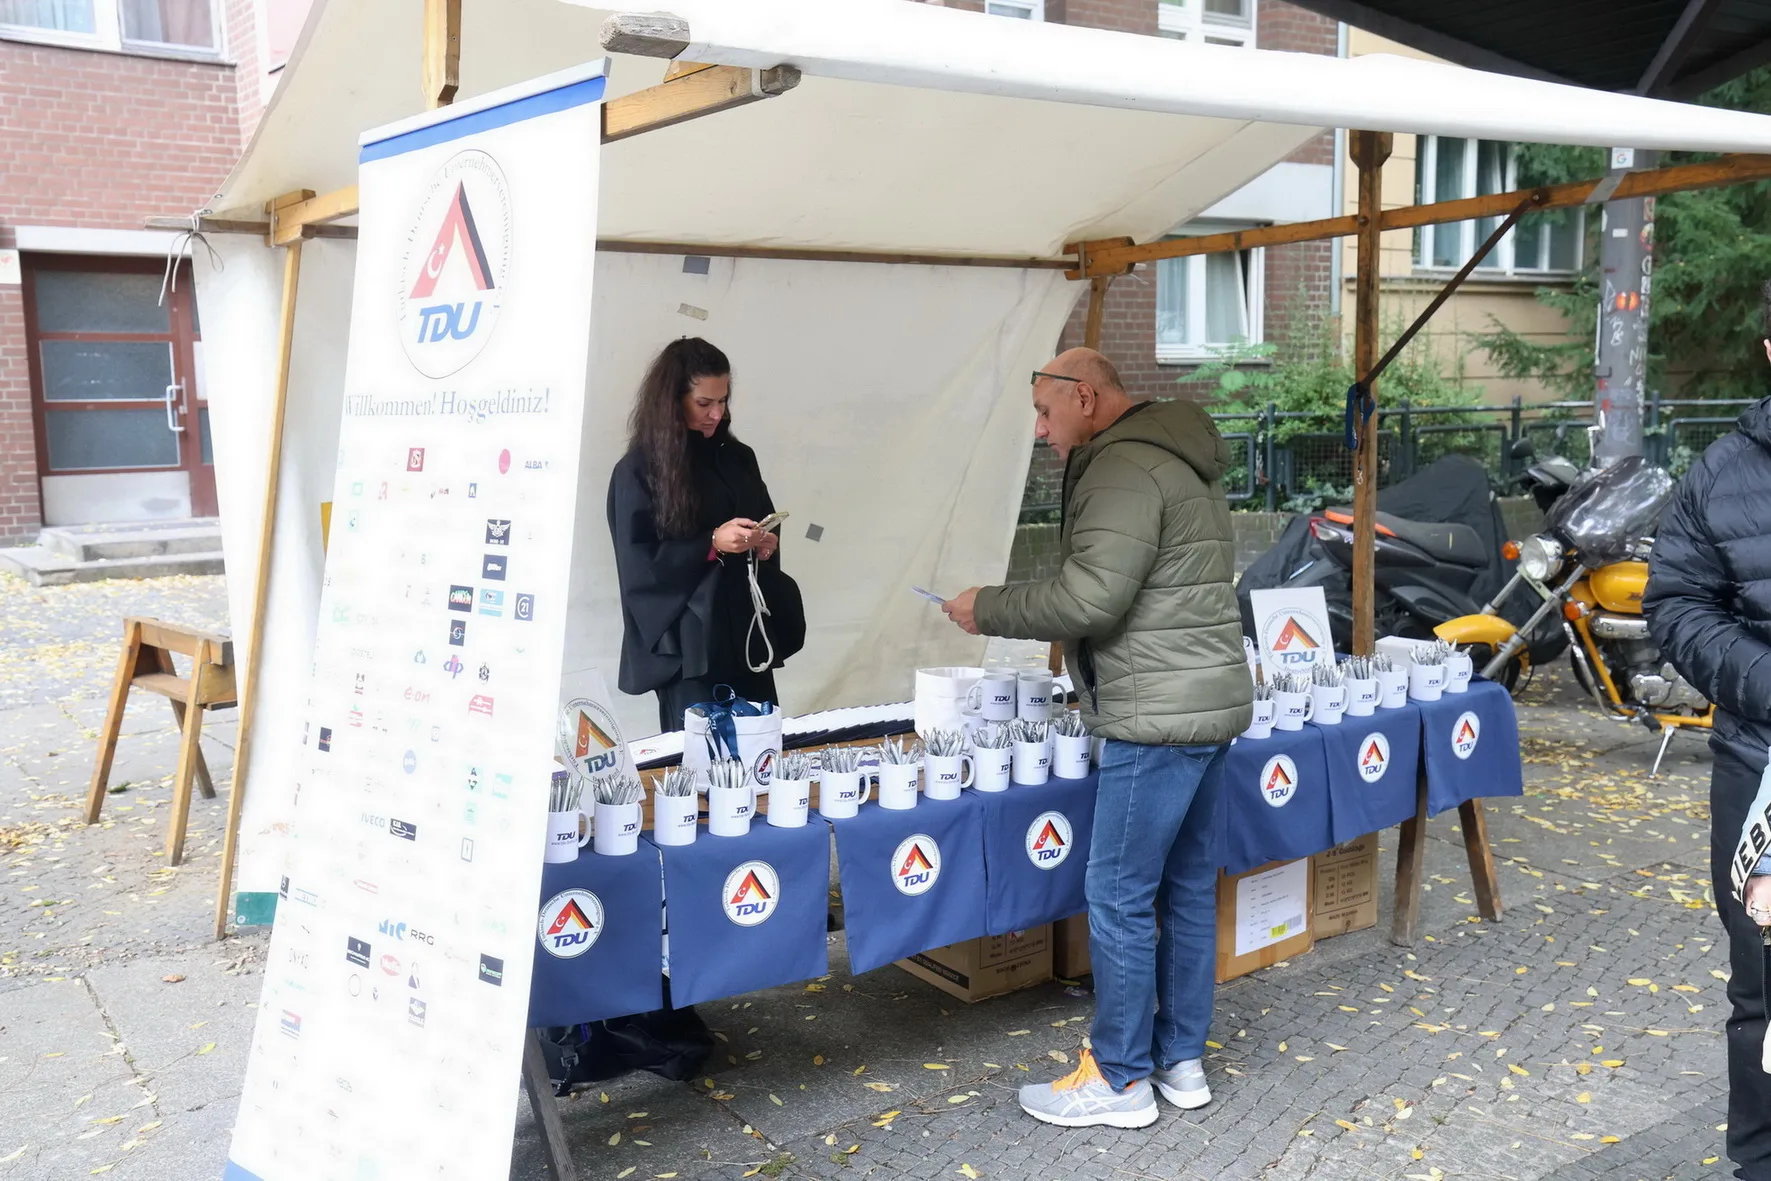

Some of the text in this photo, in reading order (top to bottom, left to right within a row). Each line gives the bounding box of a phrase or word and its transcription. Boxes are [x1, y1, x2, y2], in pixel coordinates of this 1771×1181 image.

[417, 301, 483, 344] TDU
[440, 387, 550, 424] Hoşgeldiniz!
[1280, 651, 1316, 664] TDU
[1460, 741, 1474, 752] TDU
[584, 750, 616, 774] TDU
[1000, 764, 1009, 772] TD
[1365, 764, 1382, 775] TDU
[908, 780, 917, 788] TD
[839, 790, 857, 798] TDU
[1270, 787, 1289, 800] TDU
[361, 812, 386, 829] IVECO
[557, 831, 576, 841] TDU
[1037, 848, 1061, 861] TDU
[904, 871, 930, 887] TDU
[736, 901, 767, 917] TDU
[410, 929, 436, 946] RRG
[554, 931, 589, 948] TDU
